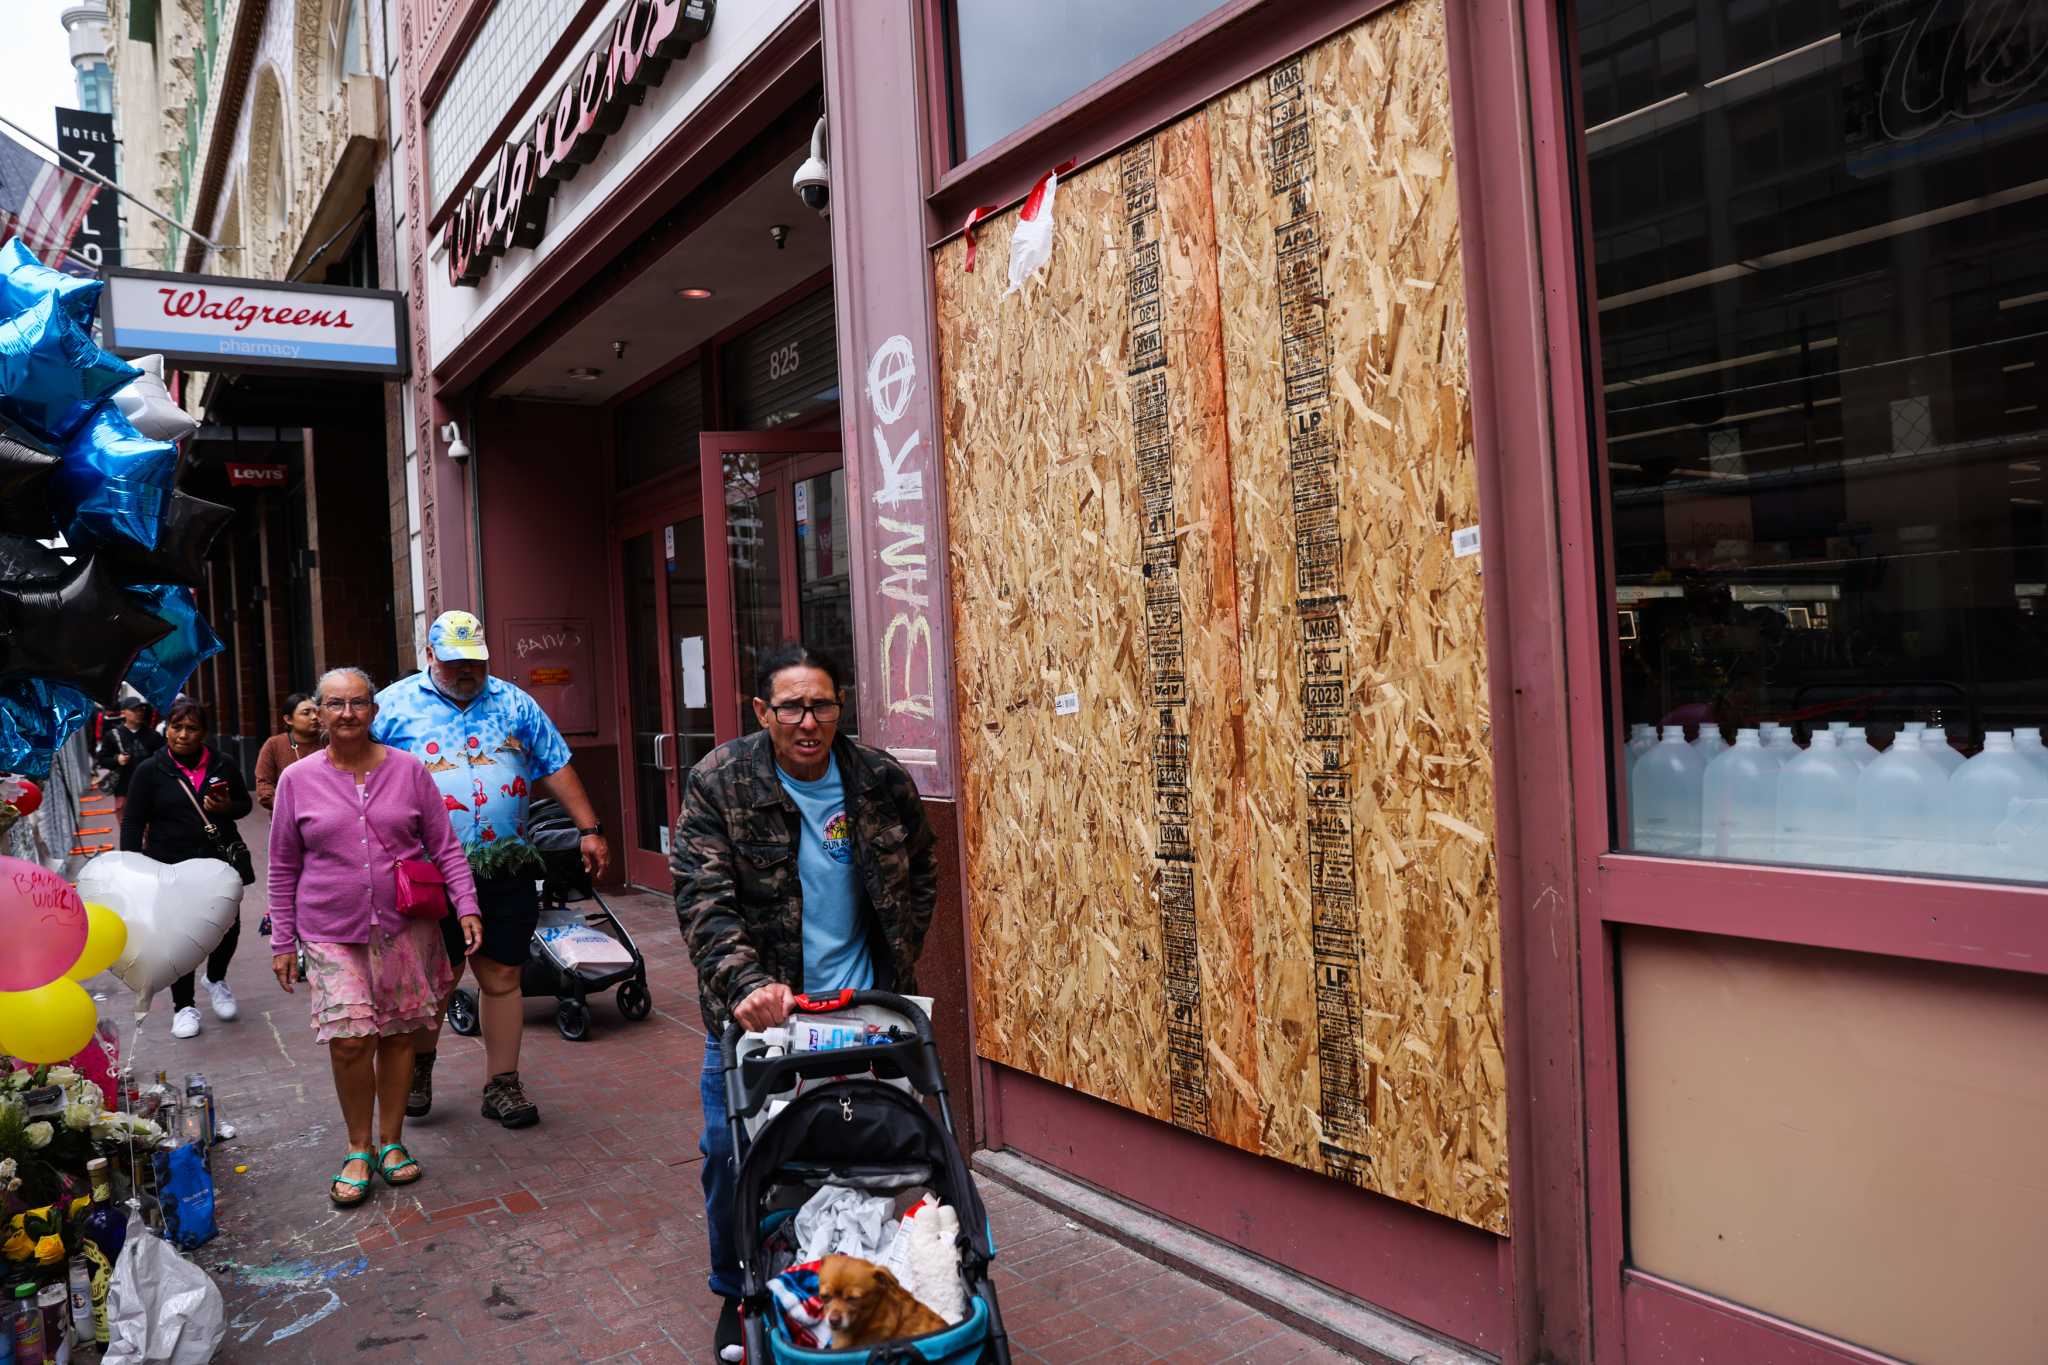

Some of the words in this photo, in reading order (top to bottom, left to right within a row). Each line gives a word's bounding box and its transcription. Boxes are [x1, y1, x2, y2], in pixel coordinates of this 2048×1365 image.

[62, 125, 108, 143] HOTEL
[158, 288, 354, 332] Walgreens
[219, 337, 301, 359] pharmacy
[769, 342, 800, 380] 825
[1309, 687, 1341, 704] 2023
[823, 841, 840, 850] SUN
